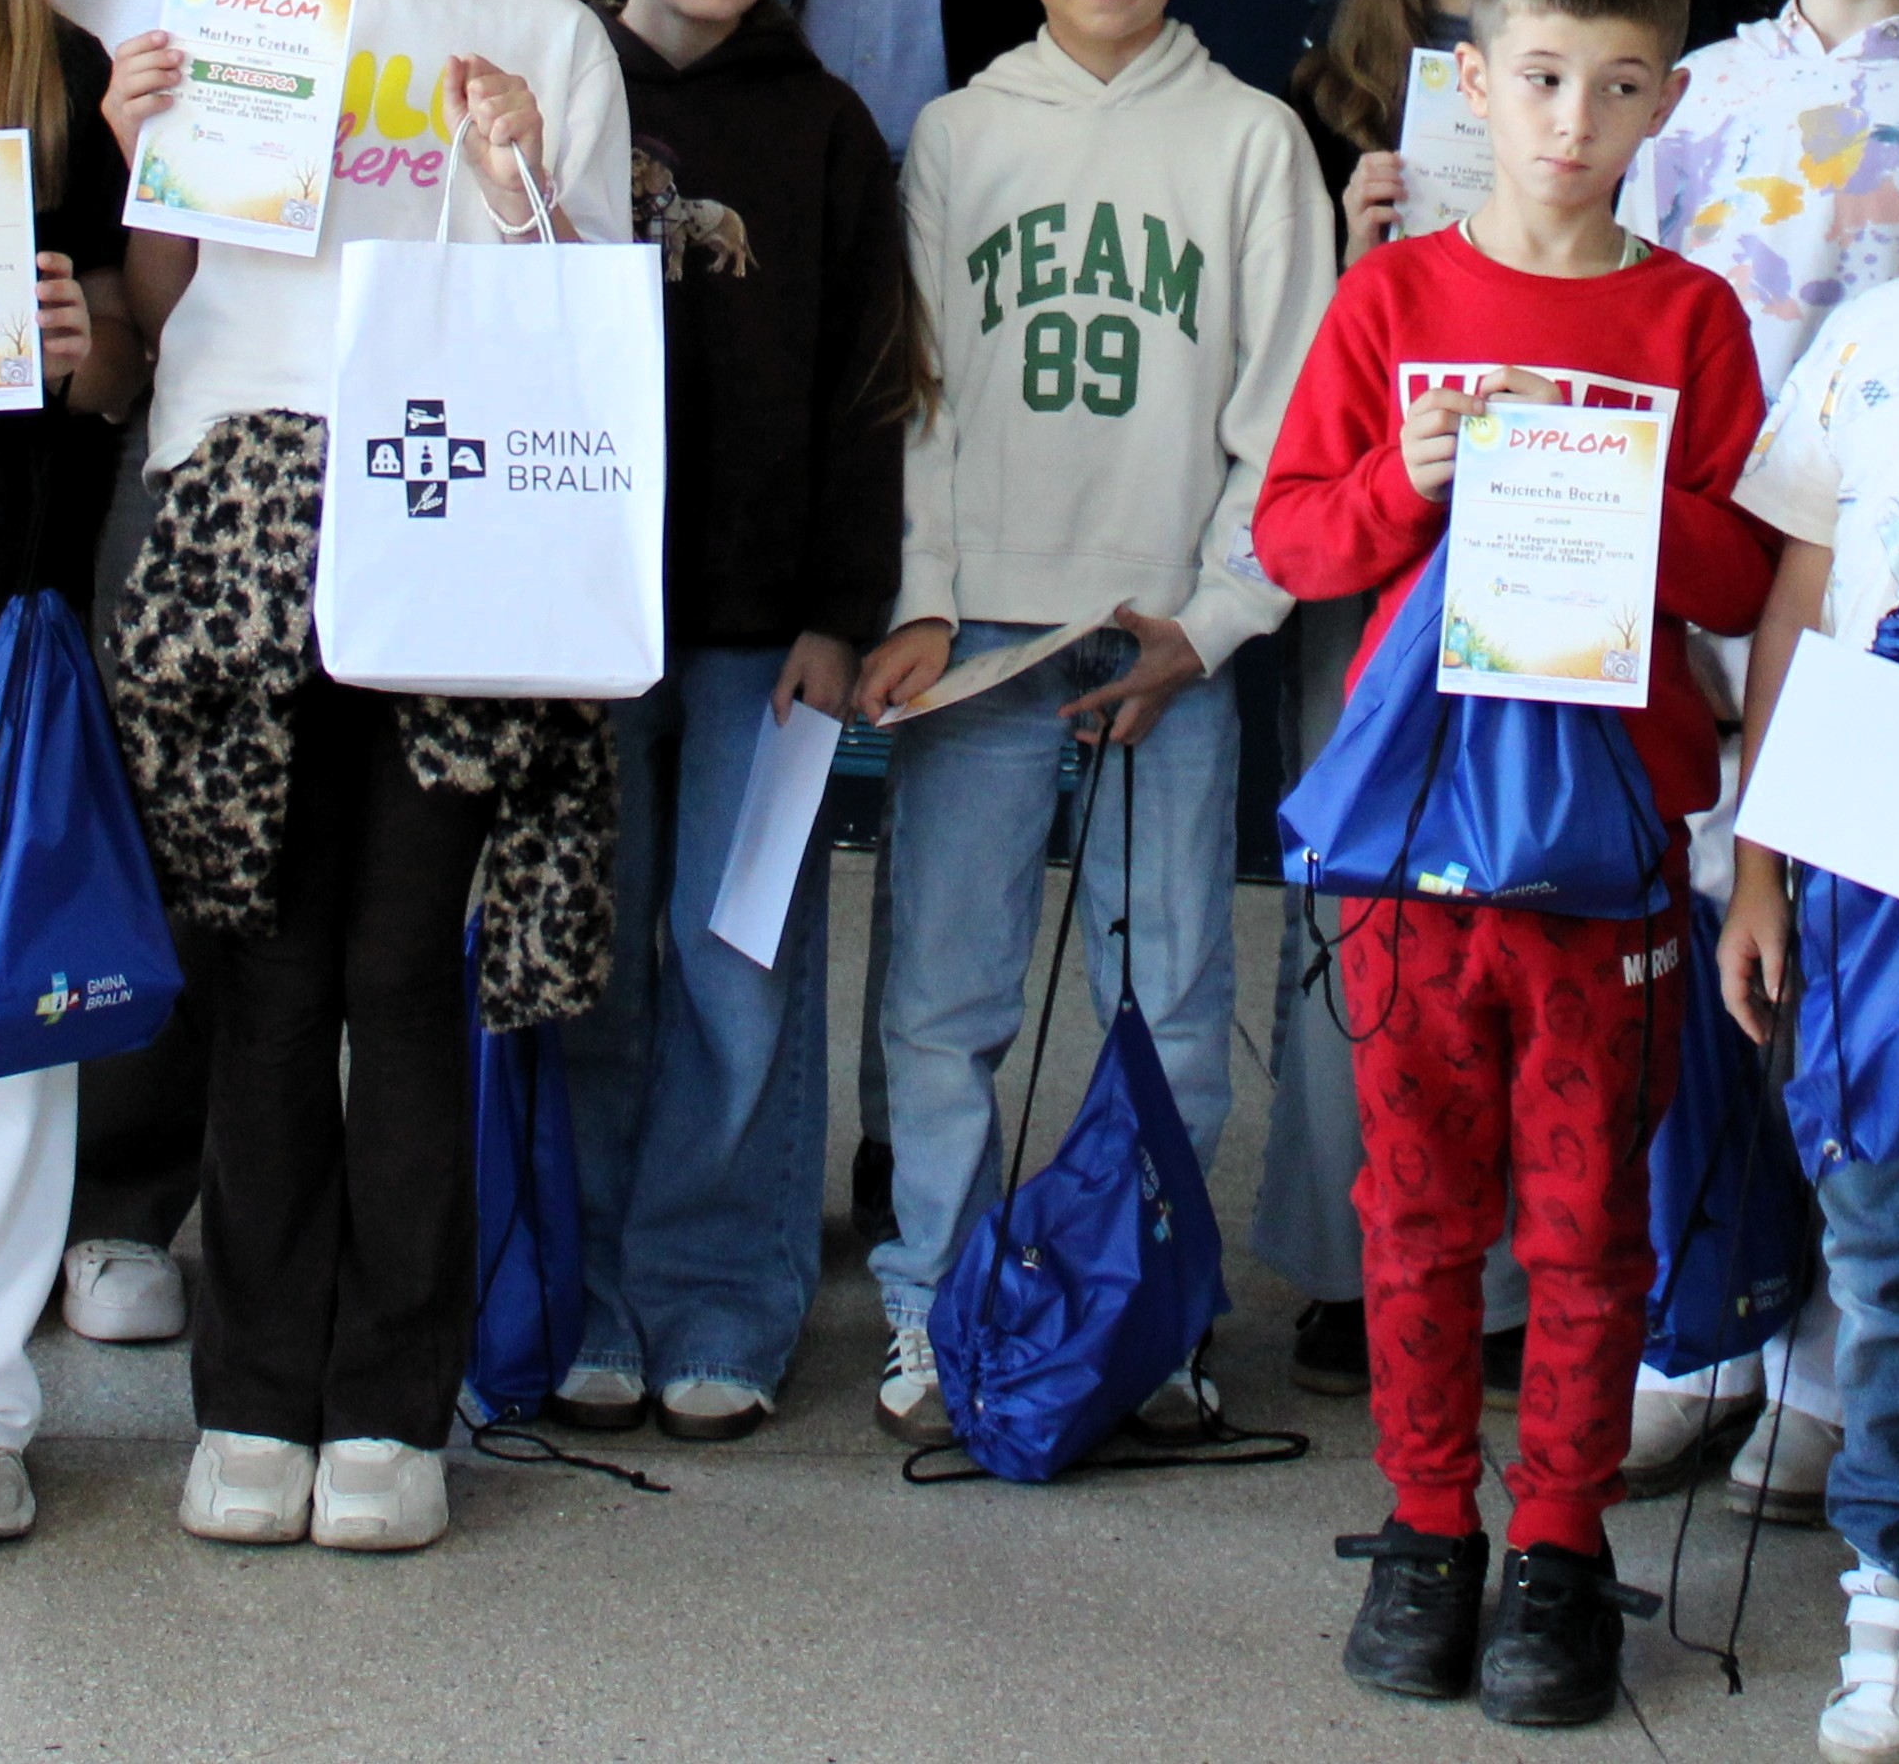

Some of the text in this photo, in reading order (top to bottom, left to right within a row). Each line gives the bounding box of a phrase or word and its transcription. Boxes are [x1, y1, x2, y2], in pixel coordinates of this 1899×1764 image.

[209, 65, 296, 91] I MIEJSCA
[966, 201, 1205, 346] TEAM
[1023, 311, 1141, 418] 89
[506, 430, 616, 457] GMINA
[1509, 428, 1628, 455] DYPLOM
[508, 465, 633, 493] BRALIN
[1490, 482, 1620, 504] Wojciecha Boczka
[87, 974, 128, 995] GMINA
[85, 987, 133, 1011] BRALIN
